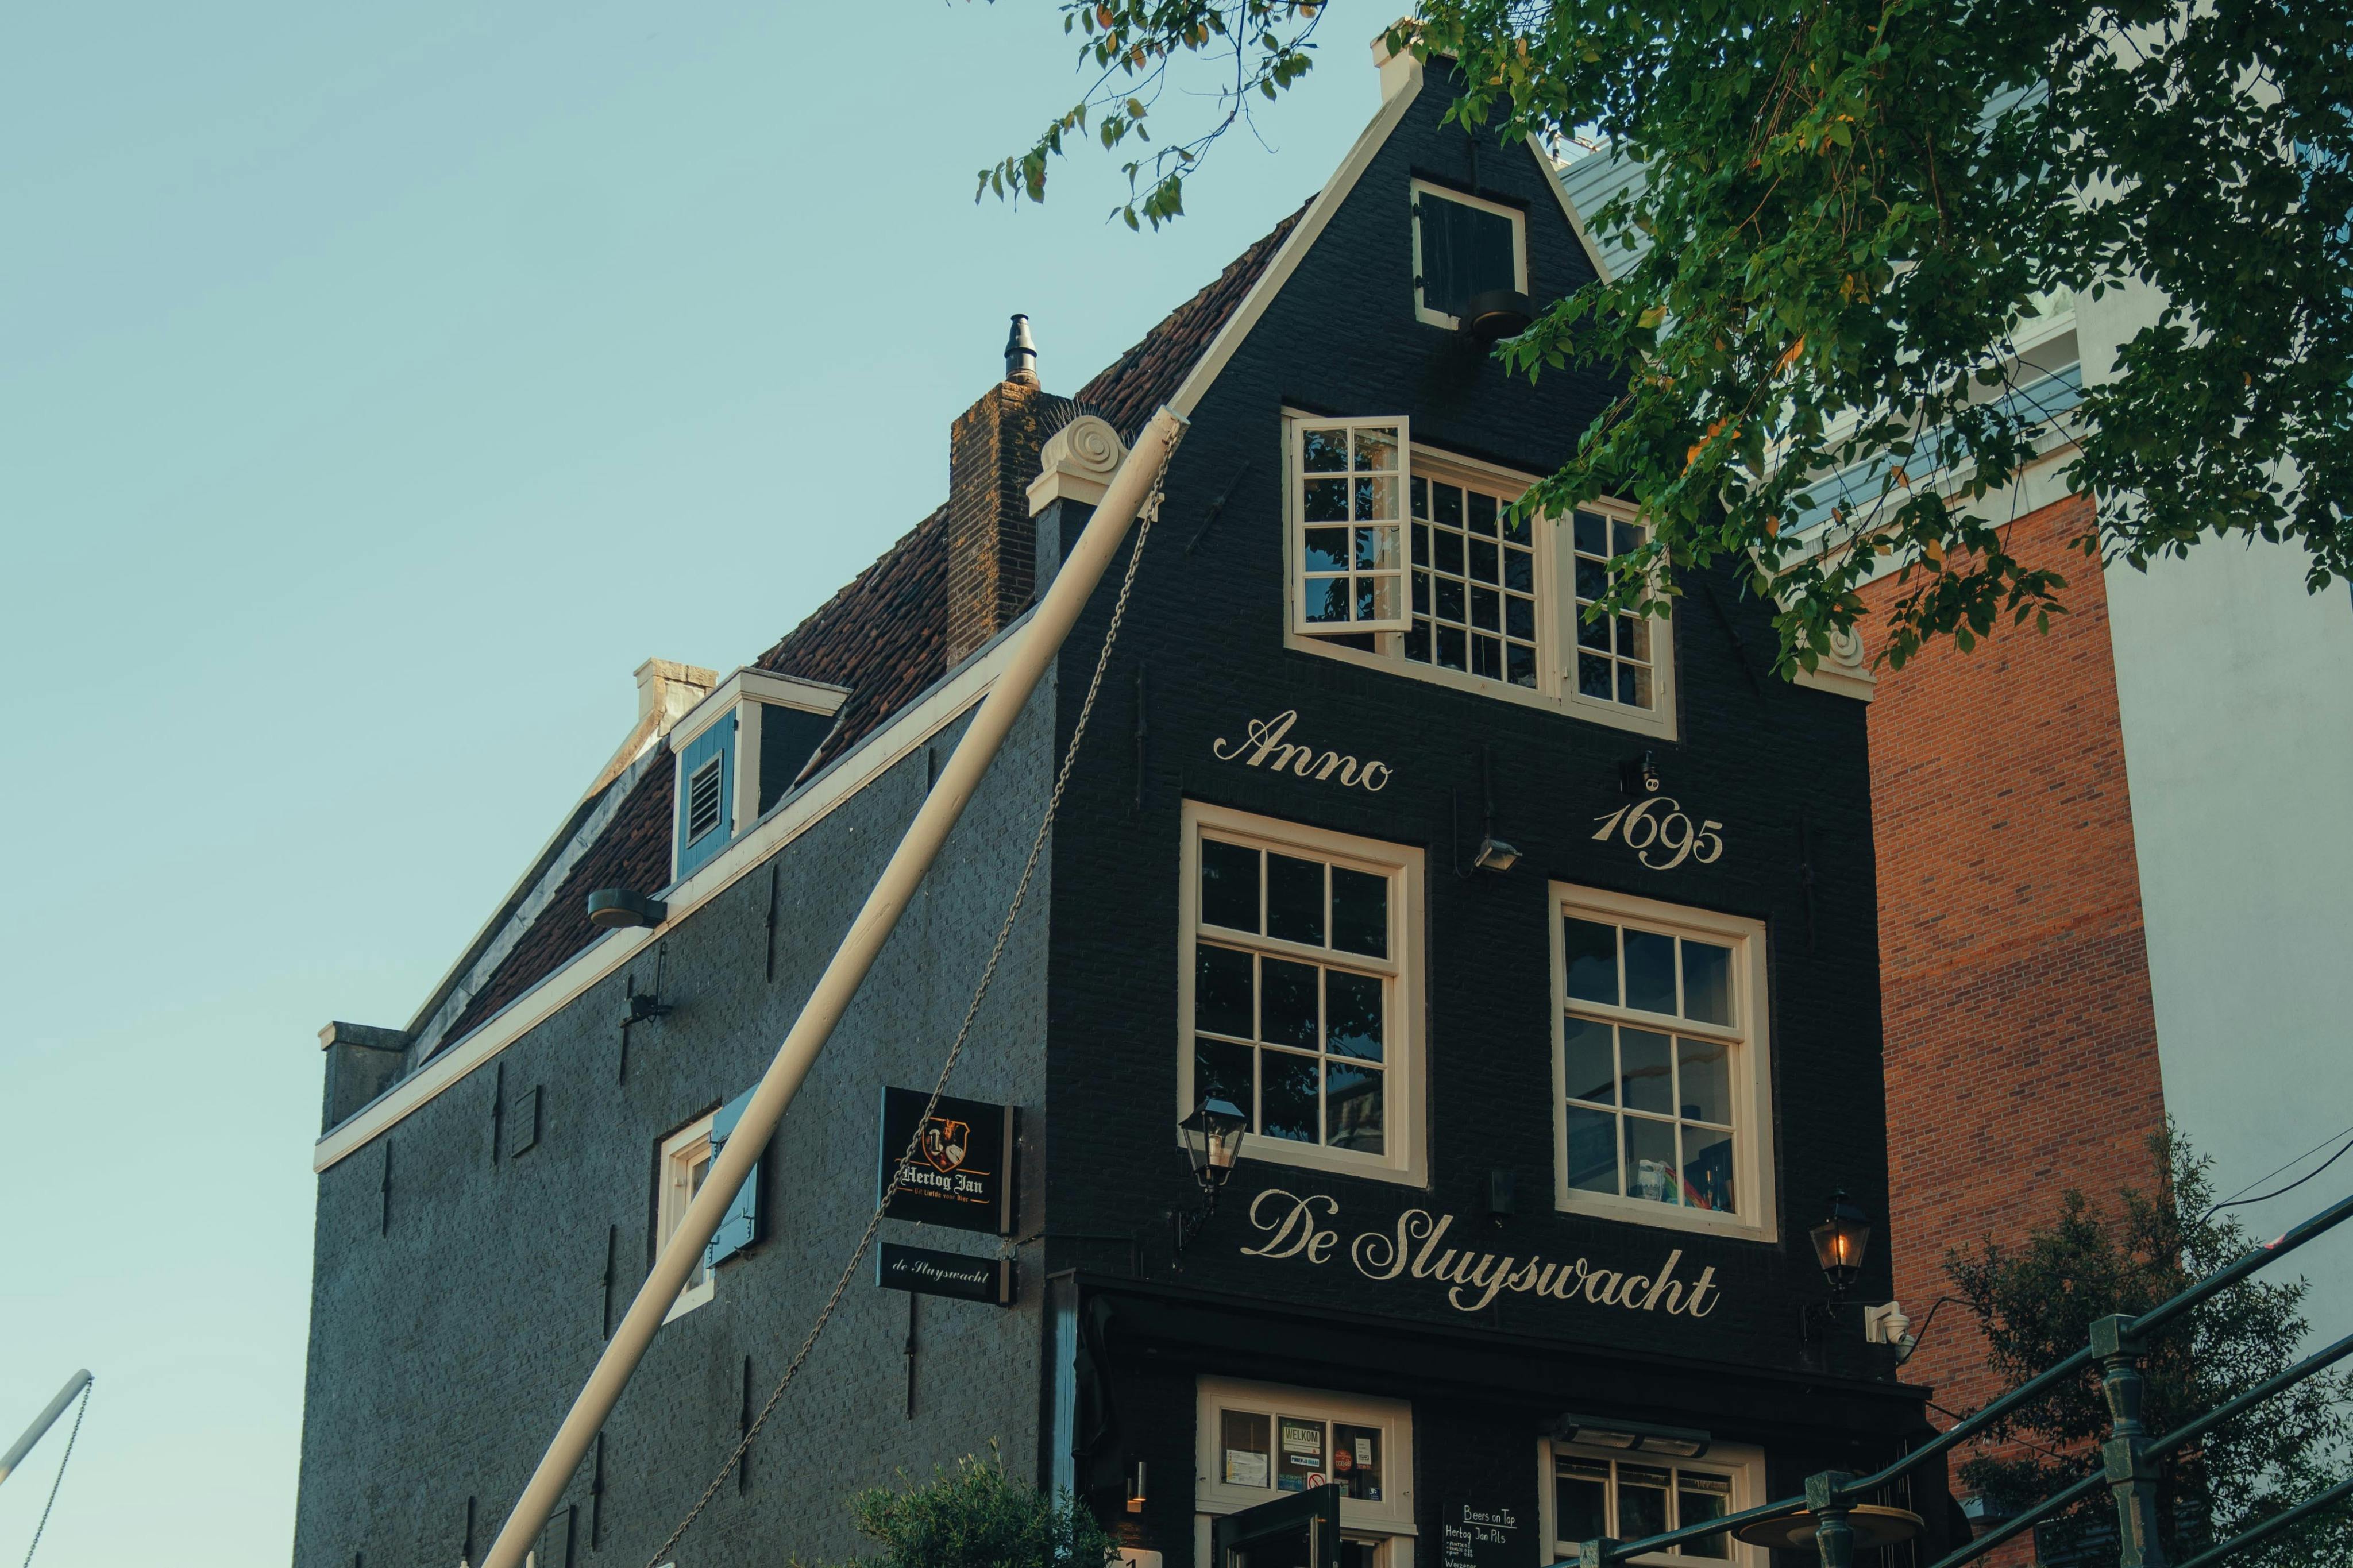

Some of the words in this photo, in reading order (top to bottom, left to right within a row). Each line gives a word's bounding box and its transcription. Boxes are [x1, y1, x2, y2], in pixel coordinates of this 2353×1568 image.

[1214, 710, 1394, 791] Anno
[1591, 797, 1723, 870] 1695
[901, 1166, 951, 1191] Hertog
[954, 1174, 983, 1195] Jan
[924, 1189, 942, 1198] Liefde
[956, 1195, 969, 1203] Bier
[1240, 1188, 1339, 1264] De
[1351, 1208, 1721, 1318] Sluyswacht
[892, 1258, 908, 1271] de
[911, 1260, 989, 1284] Sluyswacht
[1285, 1428, 1318, 1443] WELKOM
[1464, 1505, 1490, 1521] Beers
[1492, 1515, 1500, 1523] on
[1501, 1509, 1515, 1526] Tap
[1446, 1525, 1472, 1543] Hertog
[1475, 1527, 1488, 1542] Jan
[1491, 1529, 1506, 1543] Pils
